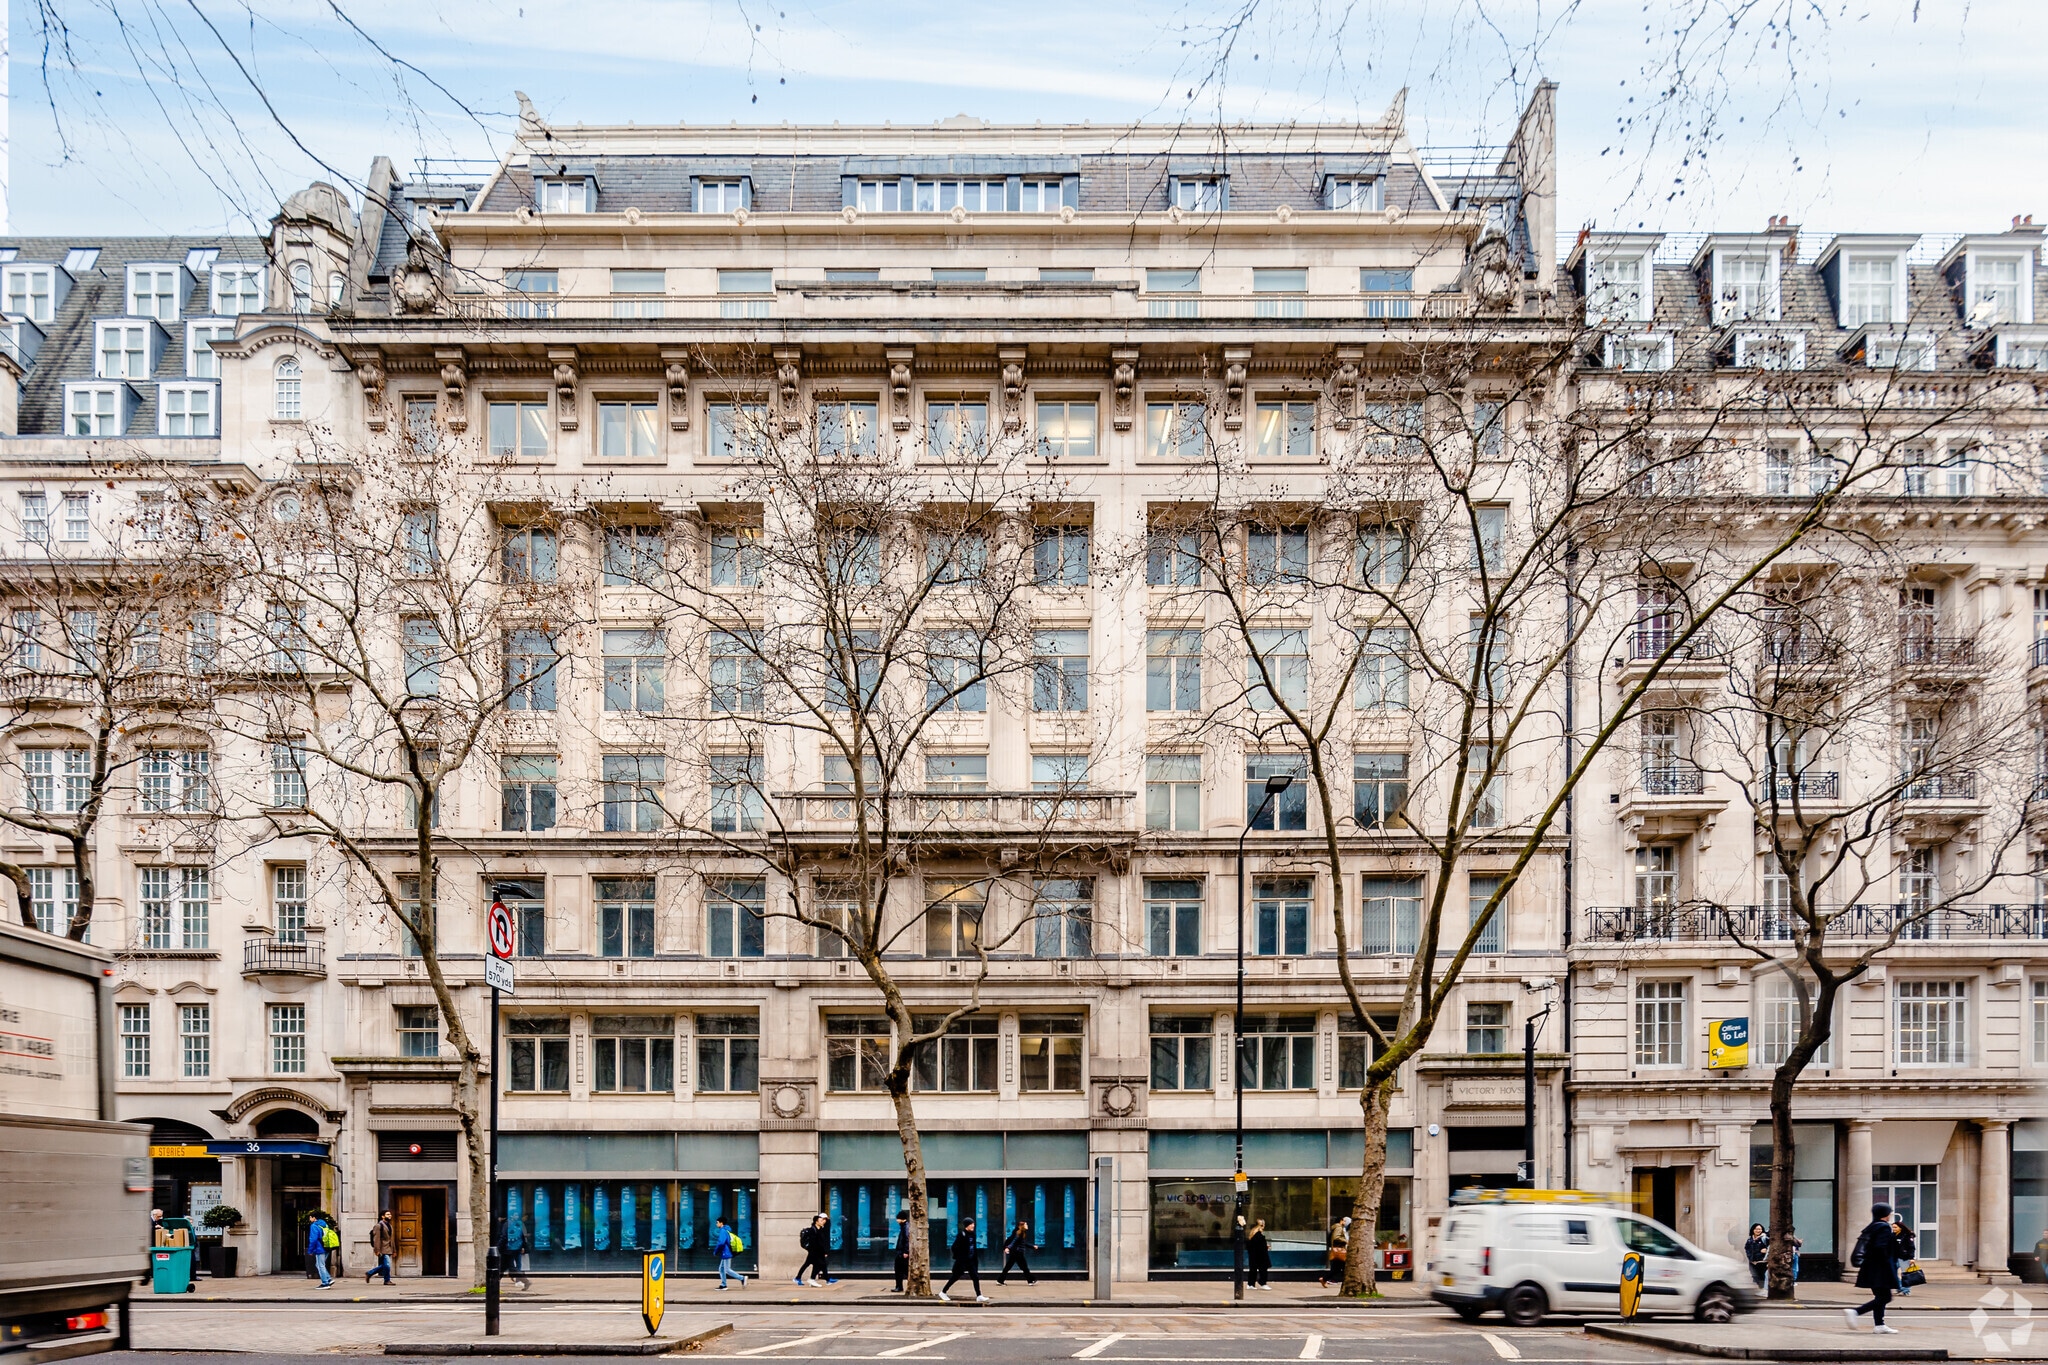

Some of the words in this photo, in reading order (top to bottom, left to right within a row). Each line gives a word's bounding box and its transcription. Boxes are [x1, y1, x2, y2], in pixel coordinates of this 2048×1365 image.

[495, 962, 505, 974] For
[488, 971, 500, 983] 570
[501, 978, 511, 988] yds
[1721, 1032, 1732, 1041] To
[1733, 1030, 1747, 1039] Let
[1459, 1087, 1496, 1095] VICTORY
[158, 1147, 186, 1157] STORIES
[246, 1142, 260, 1152] 36
[509, 1186, 517, 1211] Think
[536, 1186, 544, 1205] Talk
[622, 1186, 630, 1204] Talk
[681, 1186, 689, 1210] Think
[1166, 1194, 1212, 1203] VICTORY
[1216, 1194, 1250, 1203] HOUE
